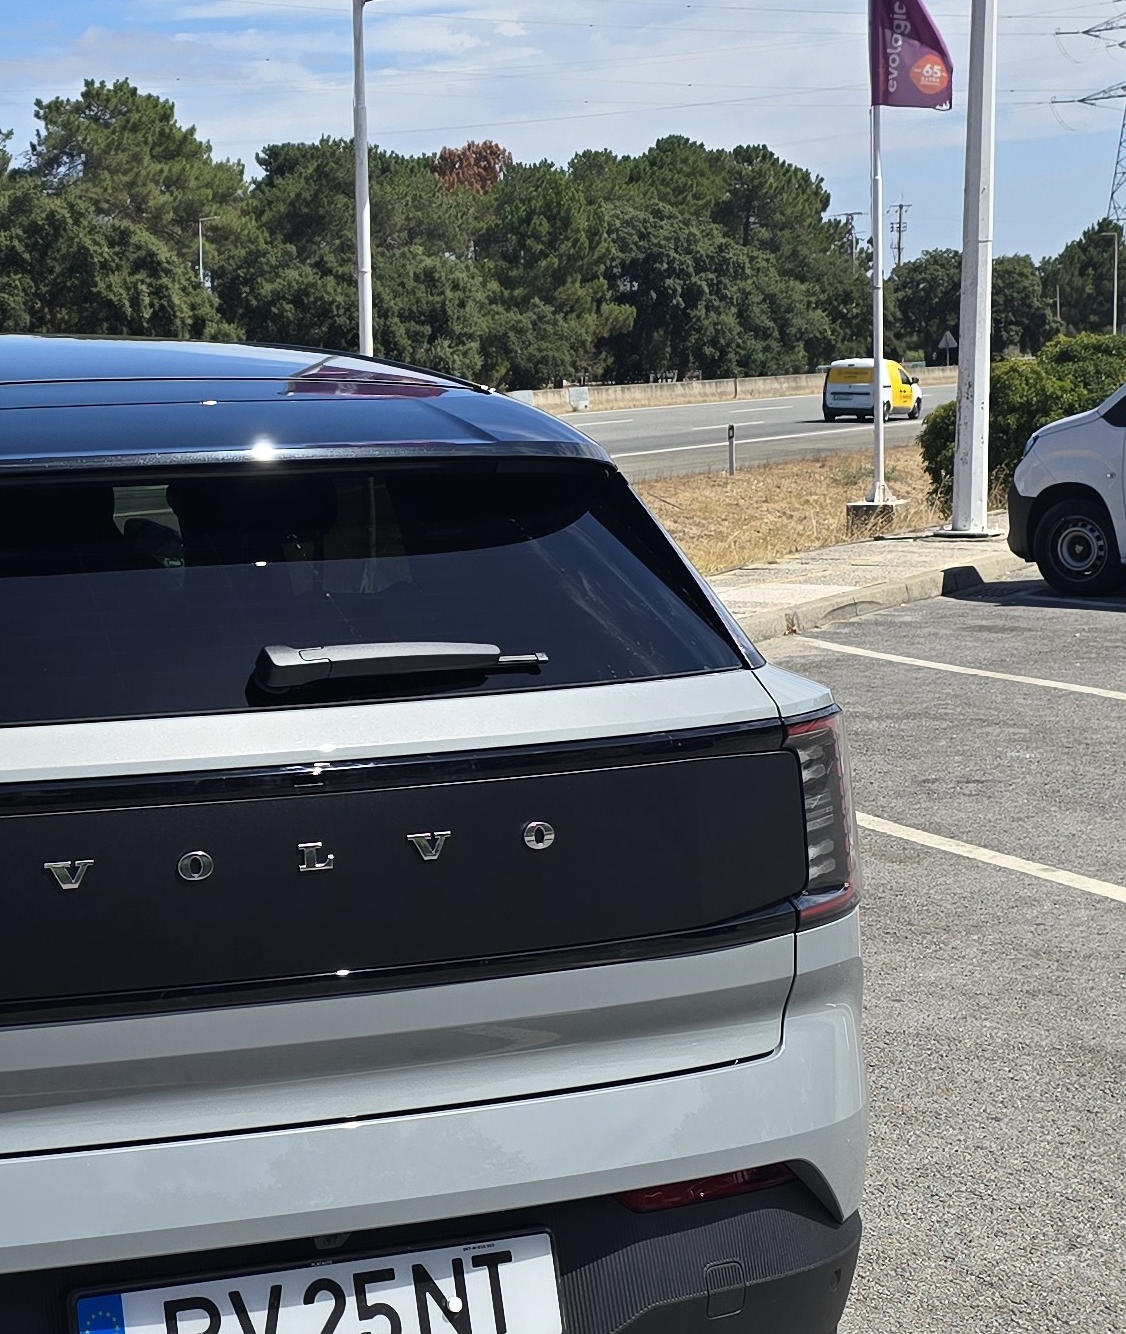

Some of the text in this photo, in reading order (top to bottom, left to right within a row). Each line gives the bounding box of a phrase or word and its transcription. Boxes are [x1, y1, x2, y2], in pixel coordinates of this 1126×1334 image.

[887, 2, 911, 93] evologic
[922, 63, 942, 78] 65
[43, 820, 556, 890] VOLVO
